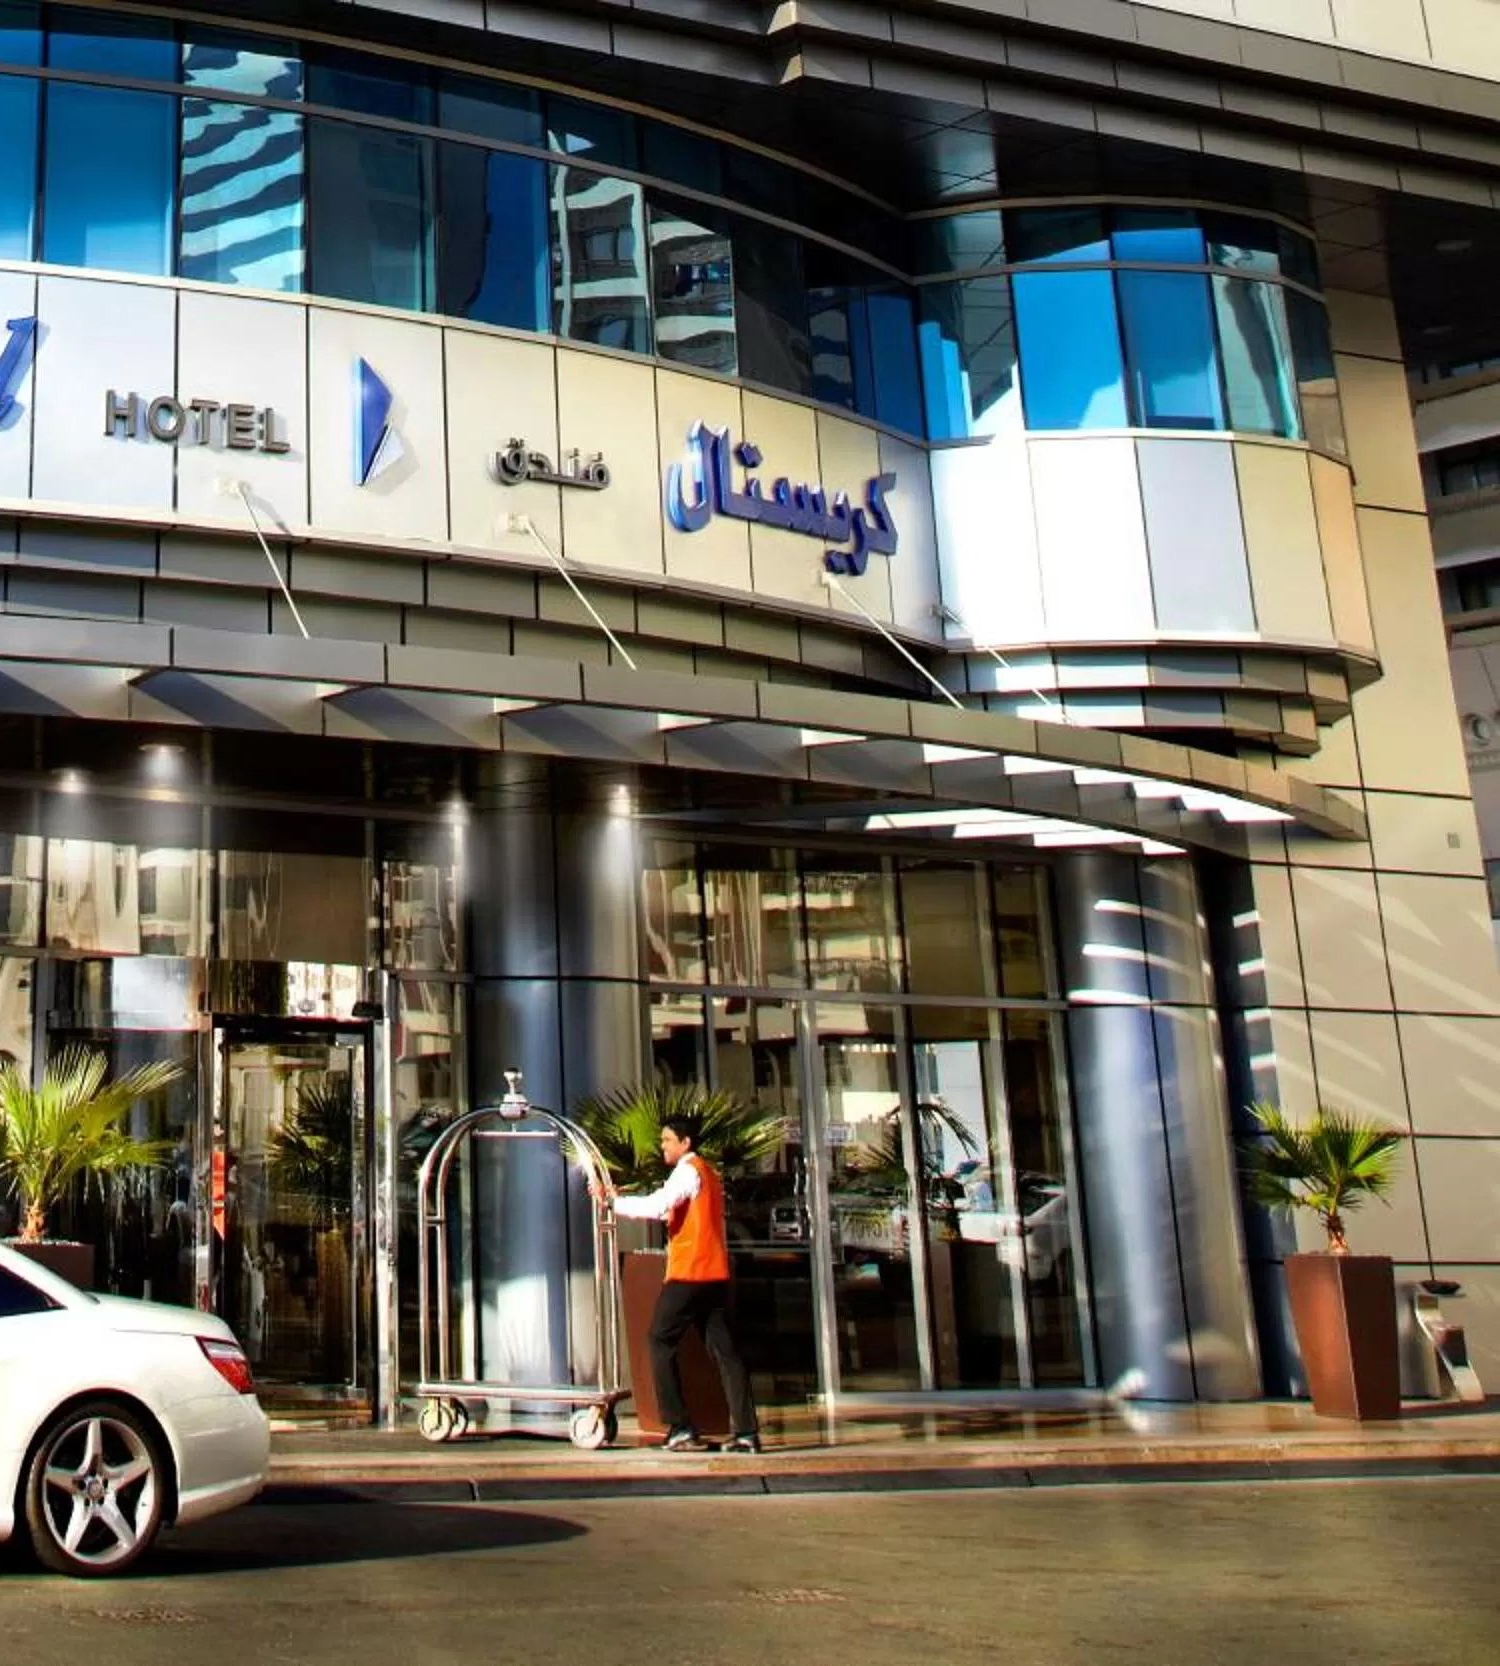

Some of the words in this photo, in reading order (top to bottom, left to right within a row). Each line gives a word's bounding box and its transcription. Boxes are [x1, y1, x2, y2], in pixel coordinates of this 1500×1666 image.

[105, 389, 291, 454] HOTEL
[491, 438, 610, 489] فندق
[665, 420, 900, 575] كريستال
